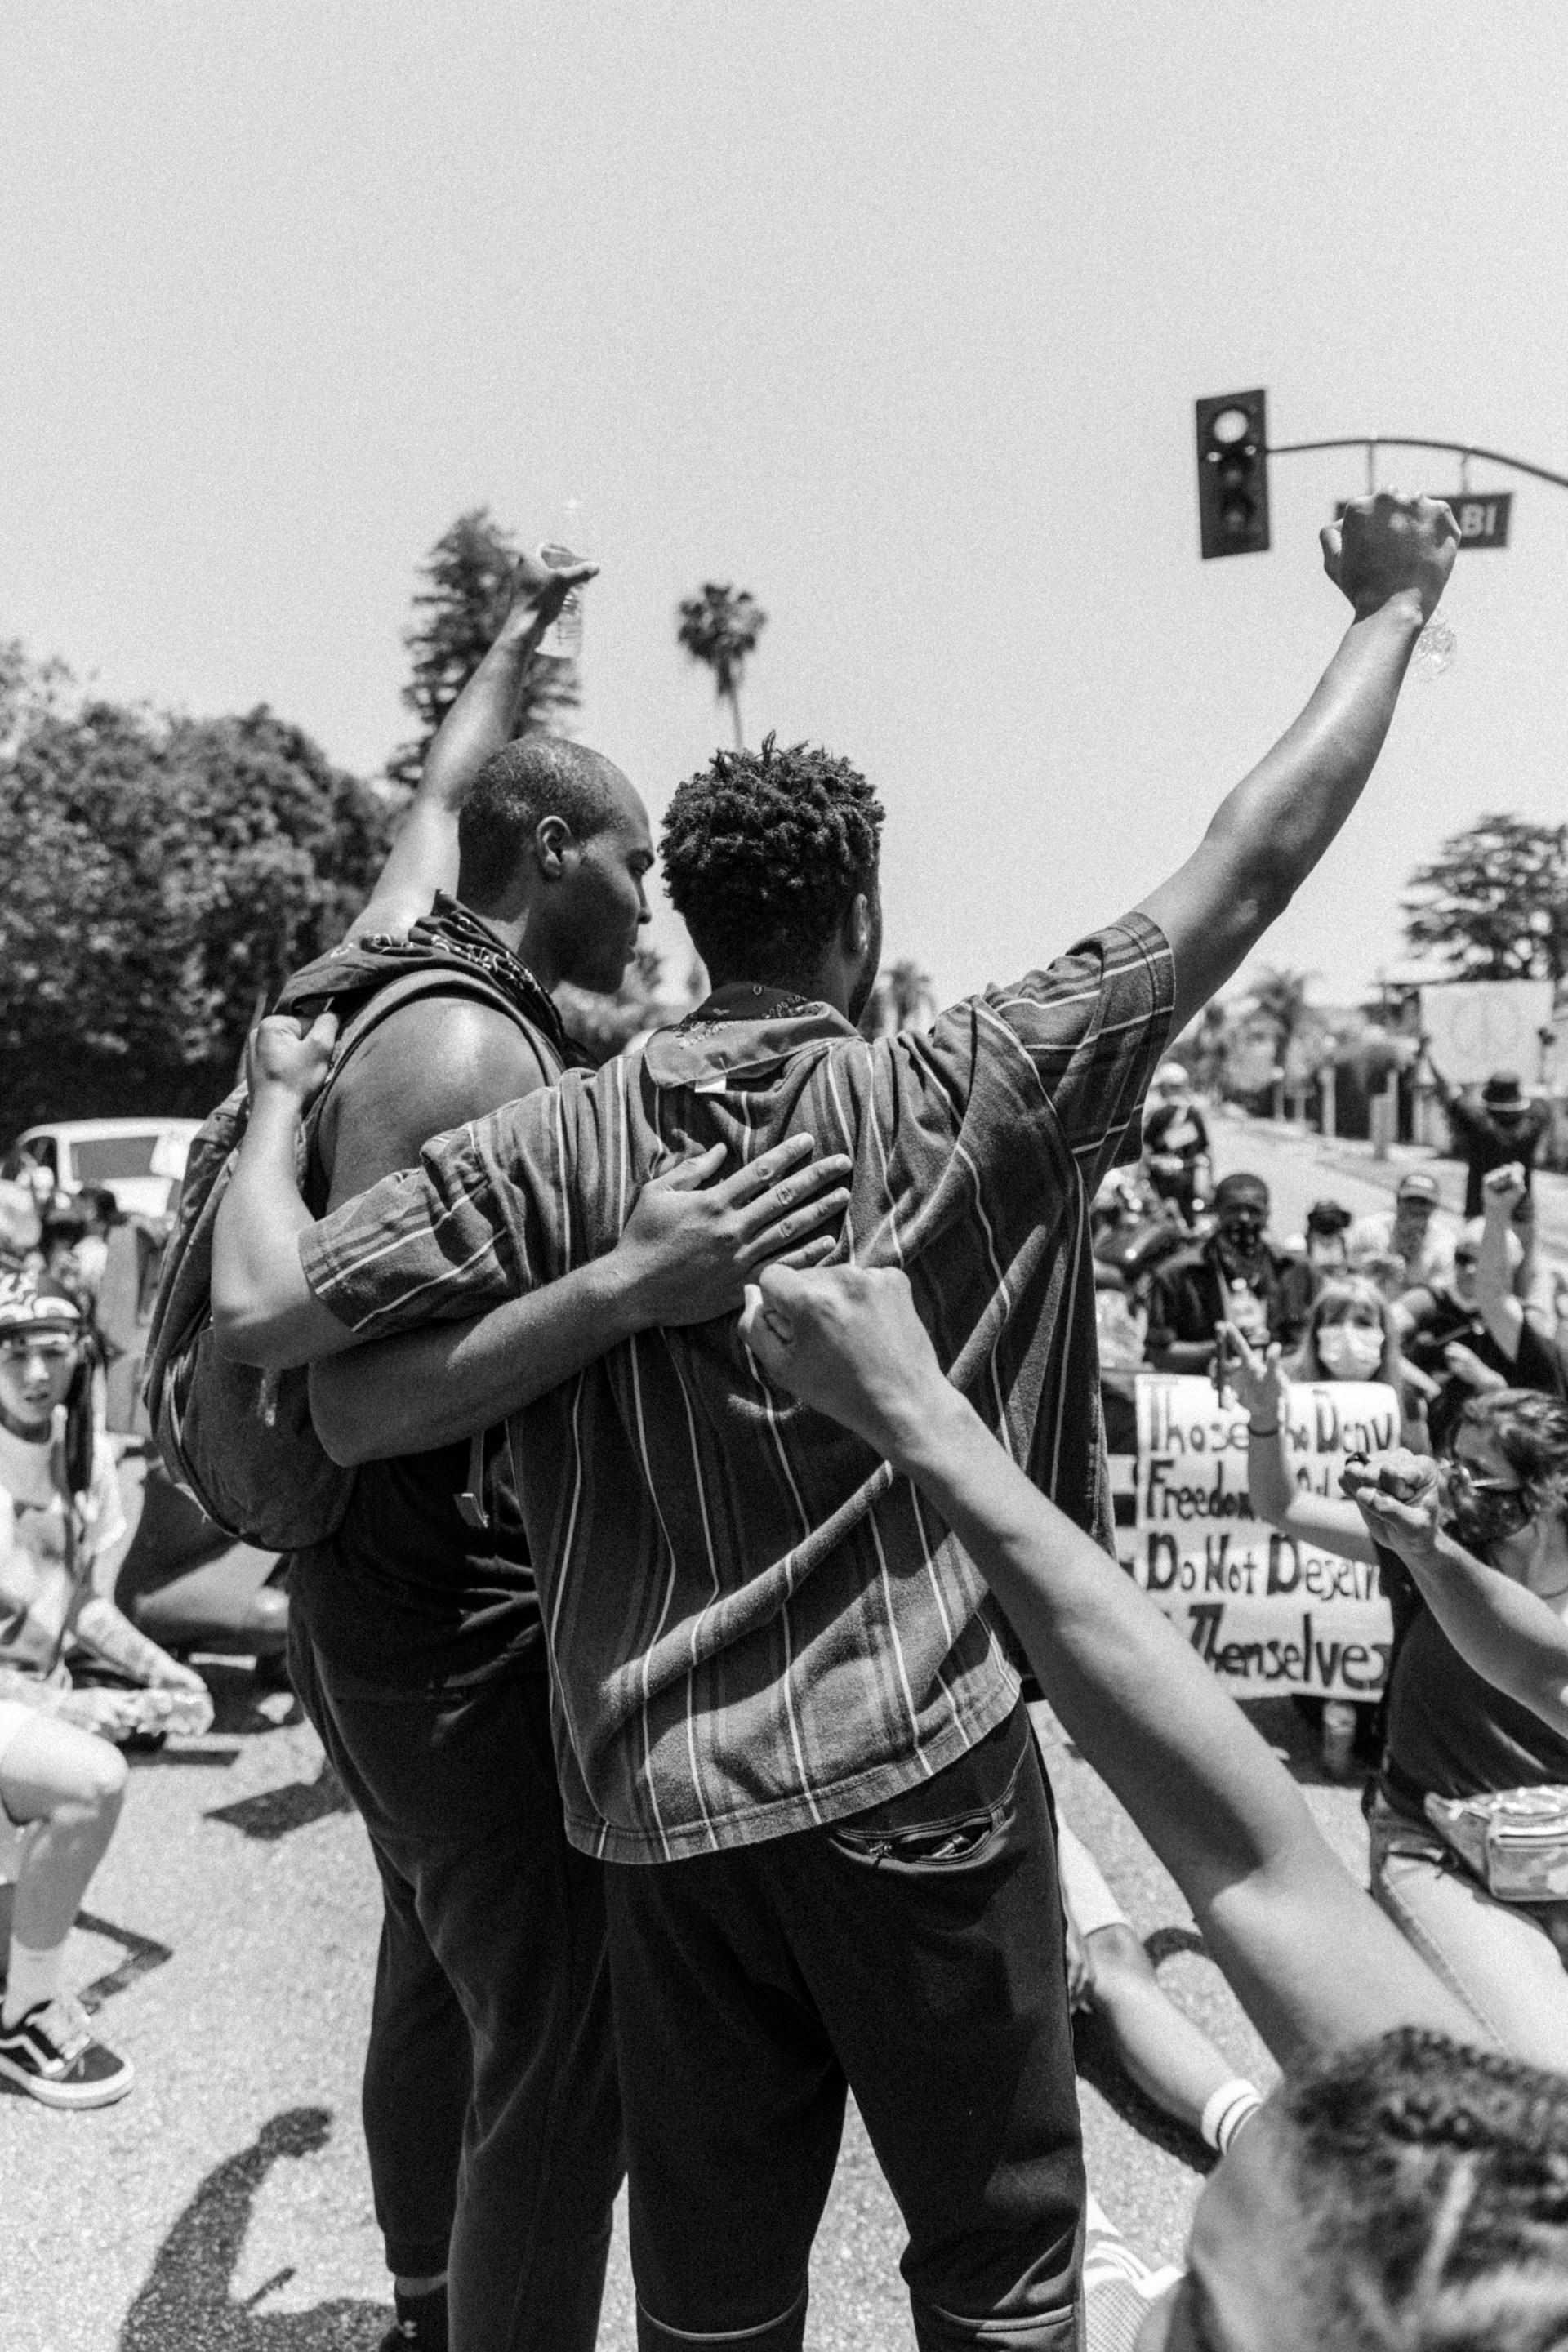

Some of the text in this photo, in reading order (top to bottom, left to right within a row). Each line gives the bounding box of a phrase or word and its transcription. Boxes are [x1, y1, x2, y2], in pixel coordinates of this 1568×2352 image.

[1143, 1378, 1249, 1451] Those
[1147, 1533, 1196, 1591] Do
[1205, 1534, 1256, 1593] Not
